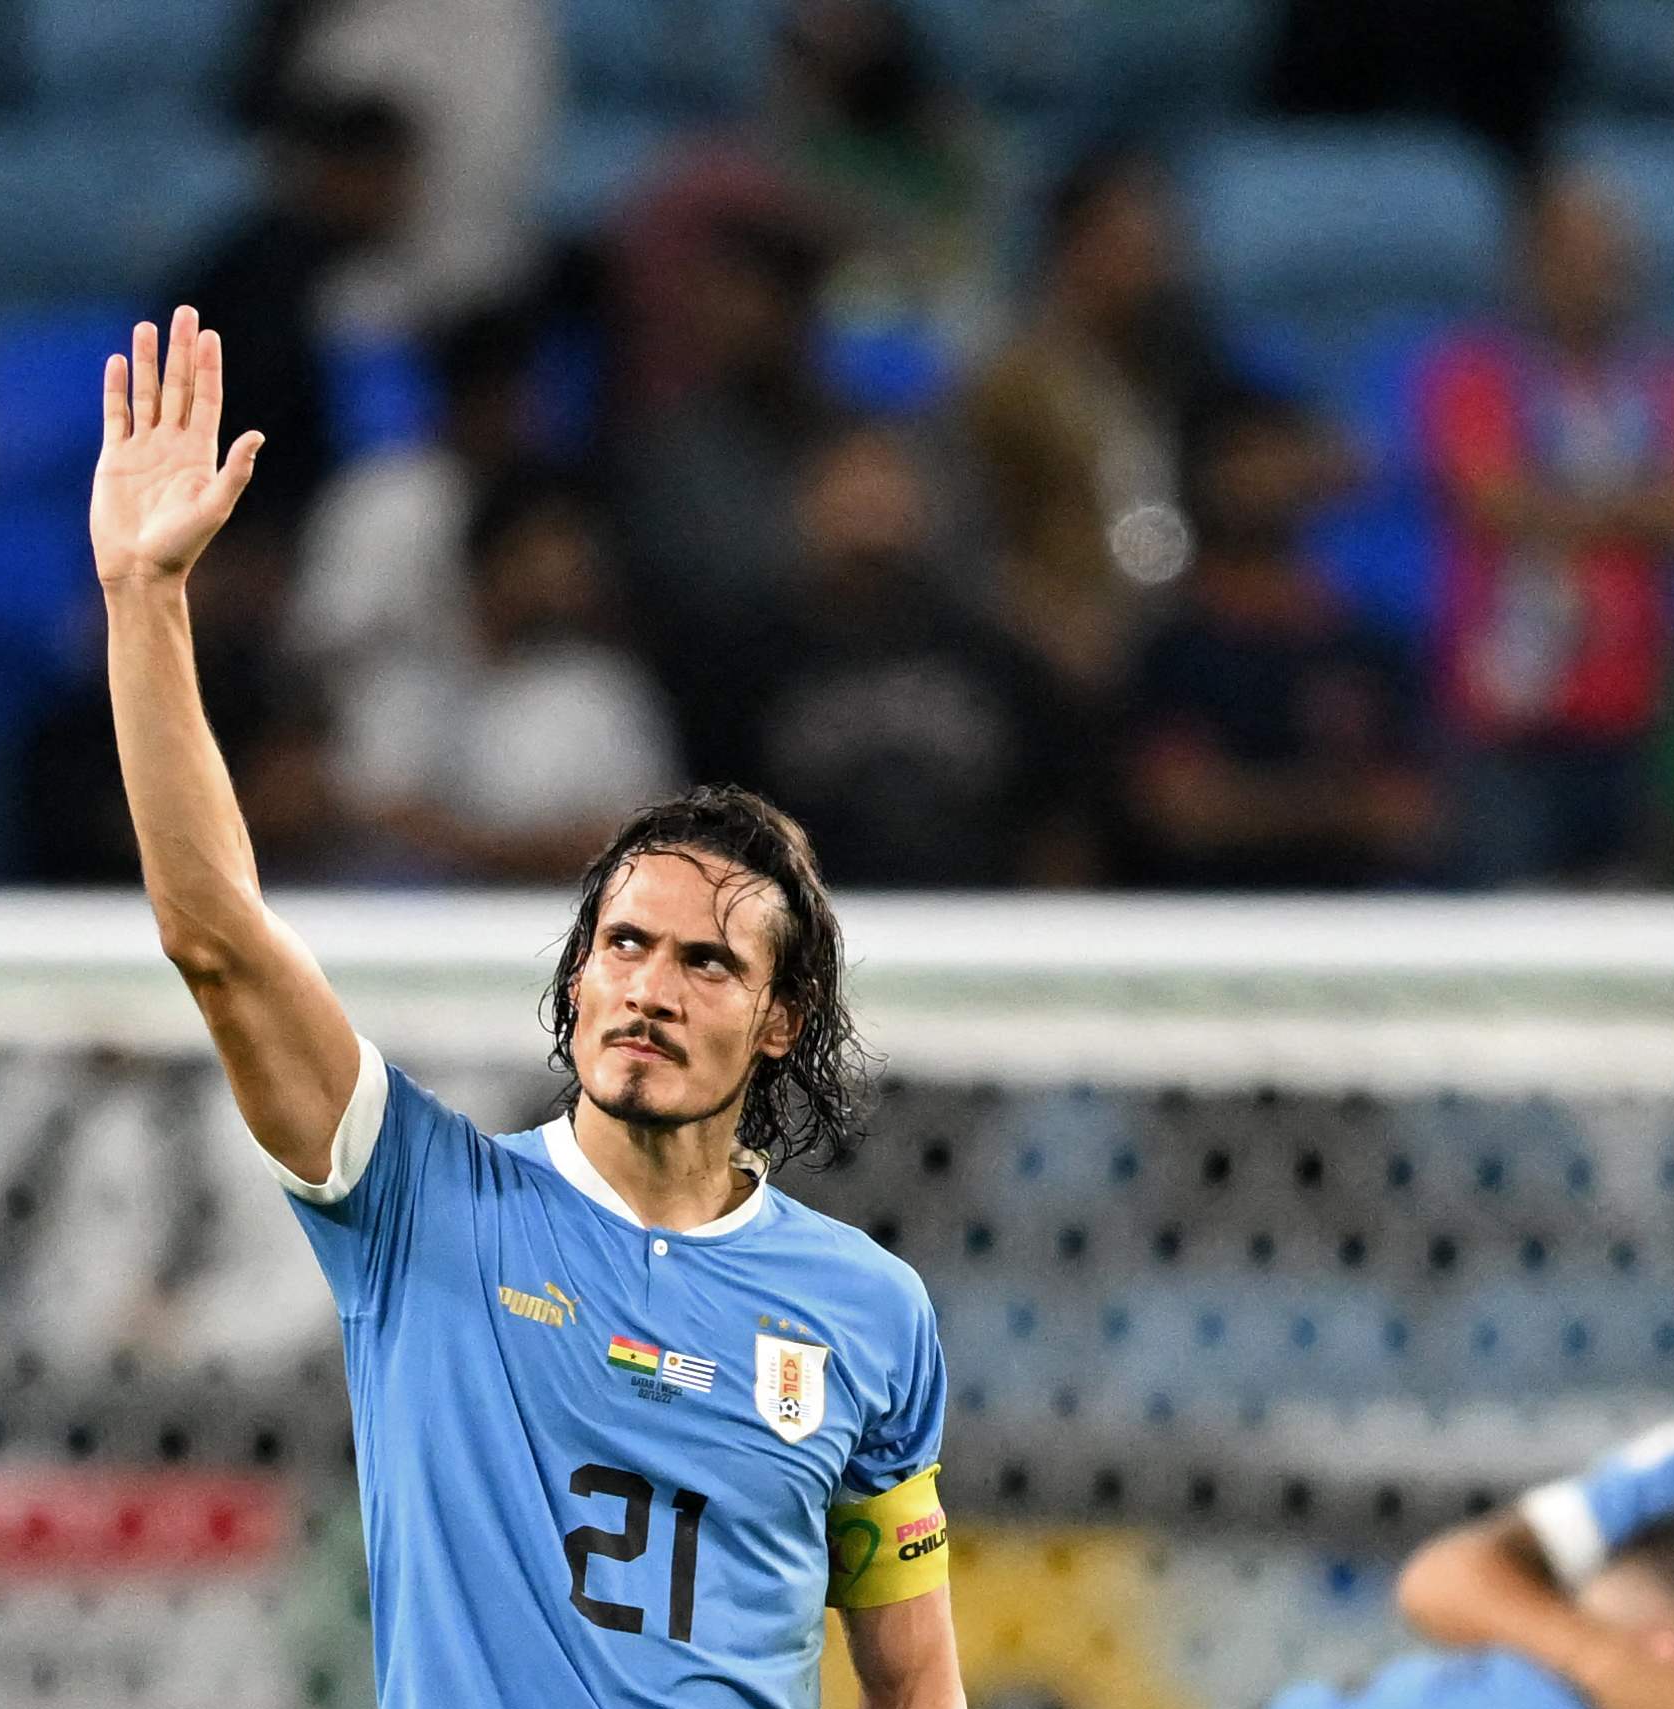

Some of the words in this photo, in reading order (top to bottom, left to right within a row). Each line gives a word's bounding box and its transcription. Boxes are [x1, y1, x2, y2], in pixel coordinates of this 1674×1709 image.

[498, 1286, 563, 1328] PUMA
[783, 1358, 799, 1394] AUF
[564, 1463, 709, 1643] 21
